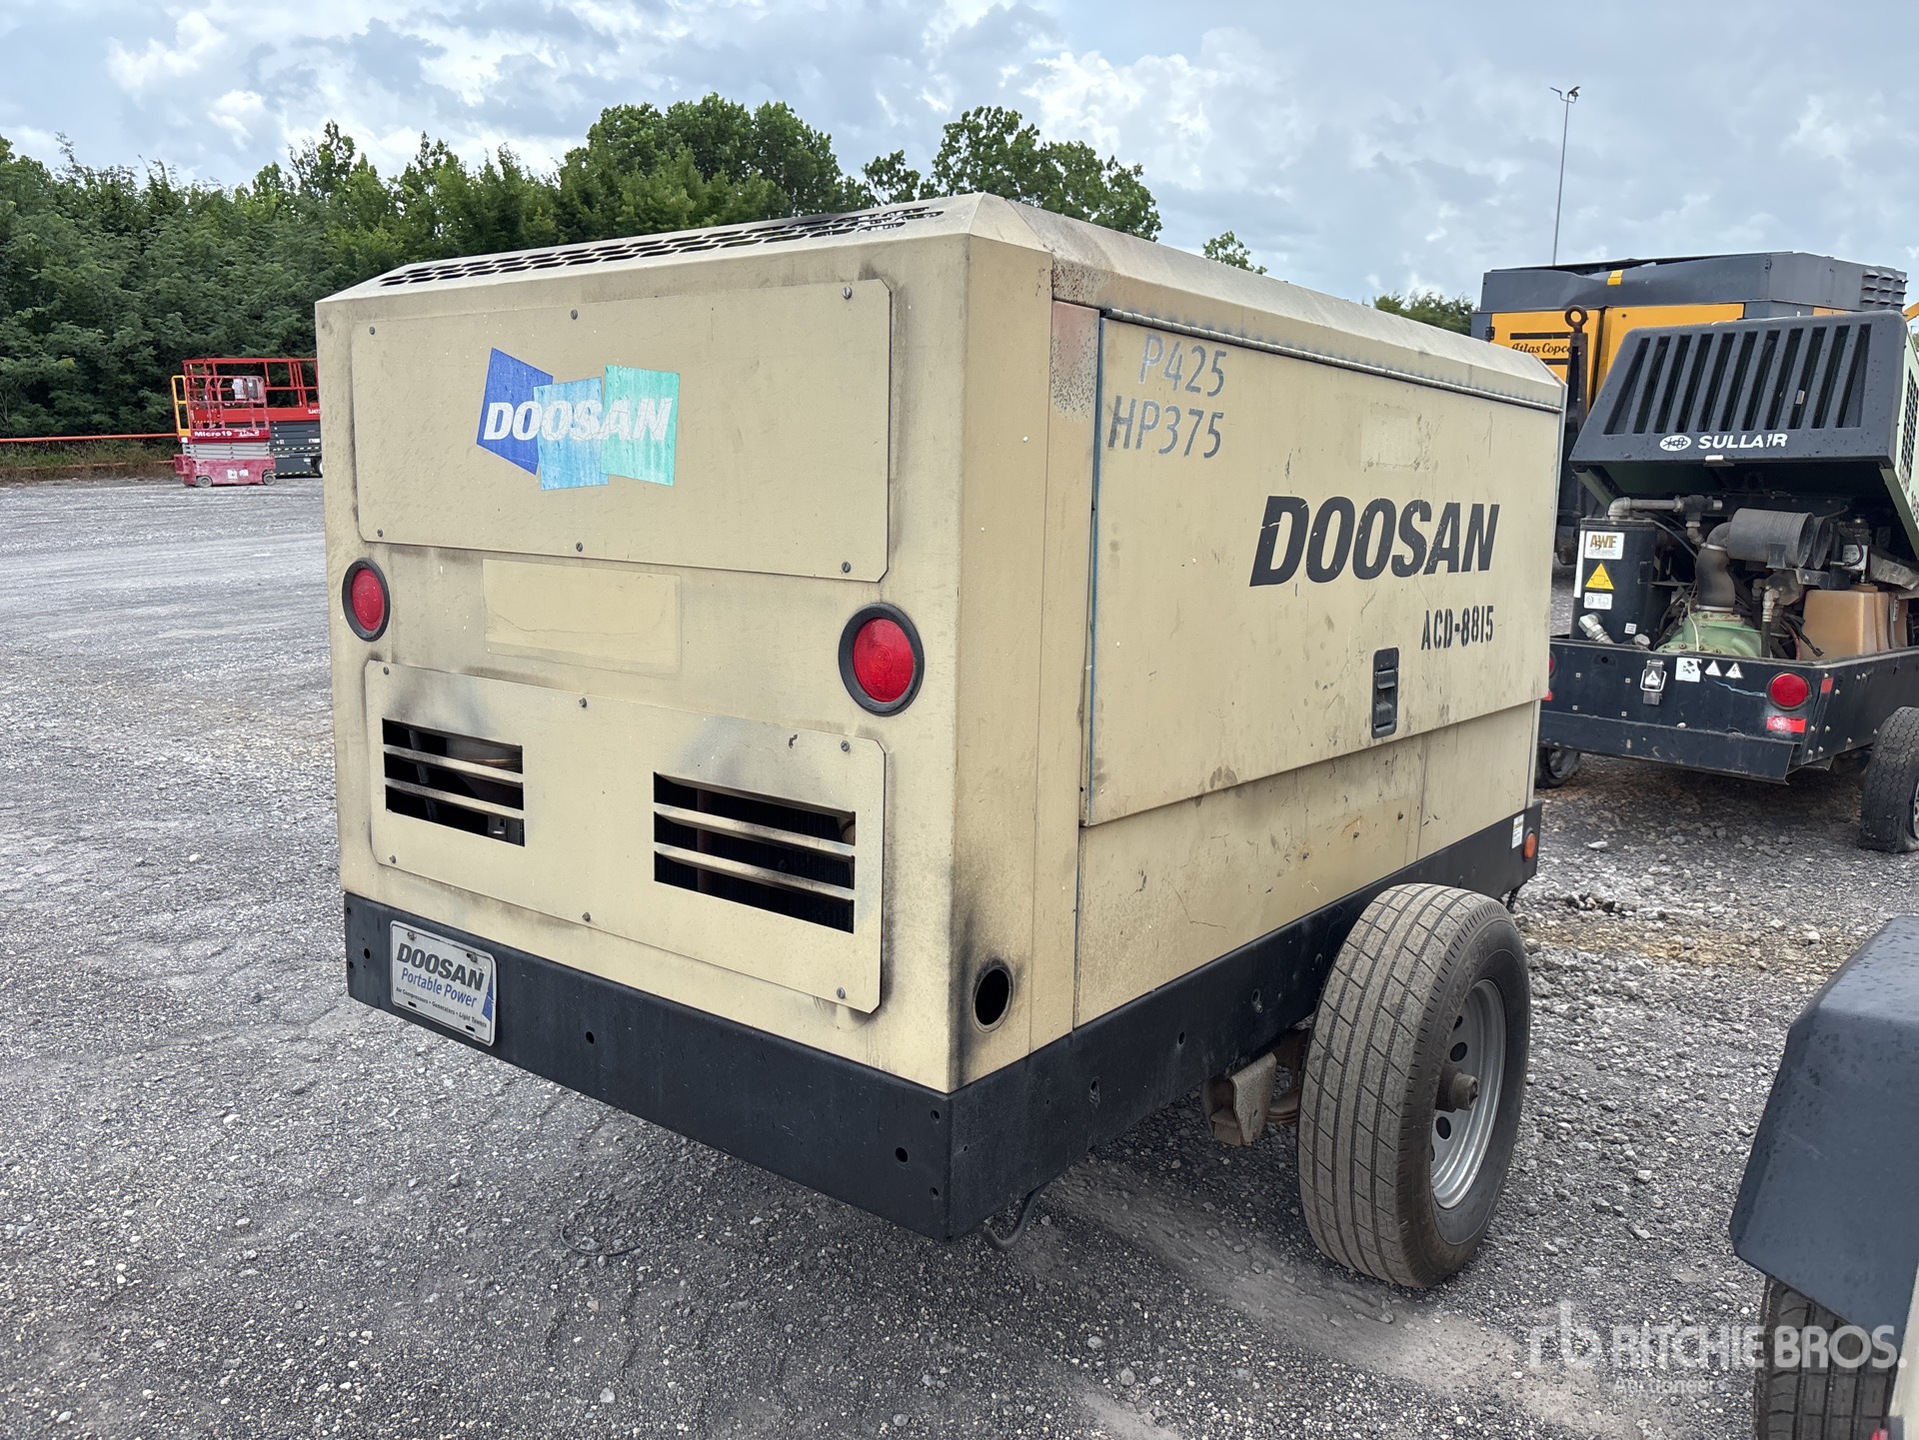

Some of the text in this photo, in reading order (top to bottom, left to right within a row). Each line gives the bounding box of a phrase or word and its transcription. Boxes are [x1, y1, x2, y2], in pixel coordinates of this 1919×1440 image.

[1138, 333, 1227, 397] P425
[483, 398, 673, 441] DOOSAN
[1107, 395, 1224, 458] HP375
[1697, 433, 1788, 450] SULLAIR
[1249, 495, 1500, 587] DOOSAN
[1420, 605, 1494, 651] ACD-8815
[396, 942, 484, 991] DOOSAN
[401, 967, 478, 1008] Portable Power
[431, 1000, 456, 1015] Generators
[458, 1012, 471, 1022] Light
